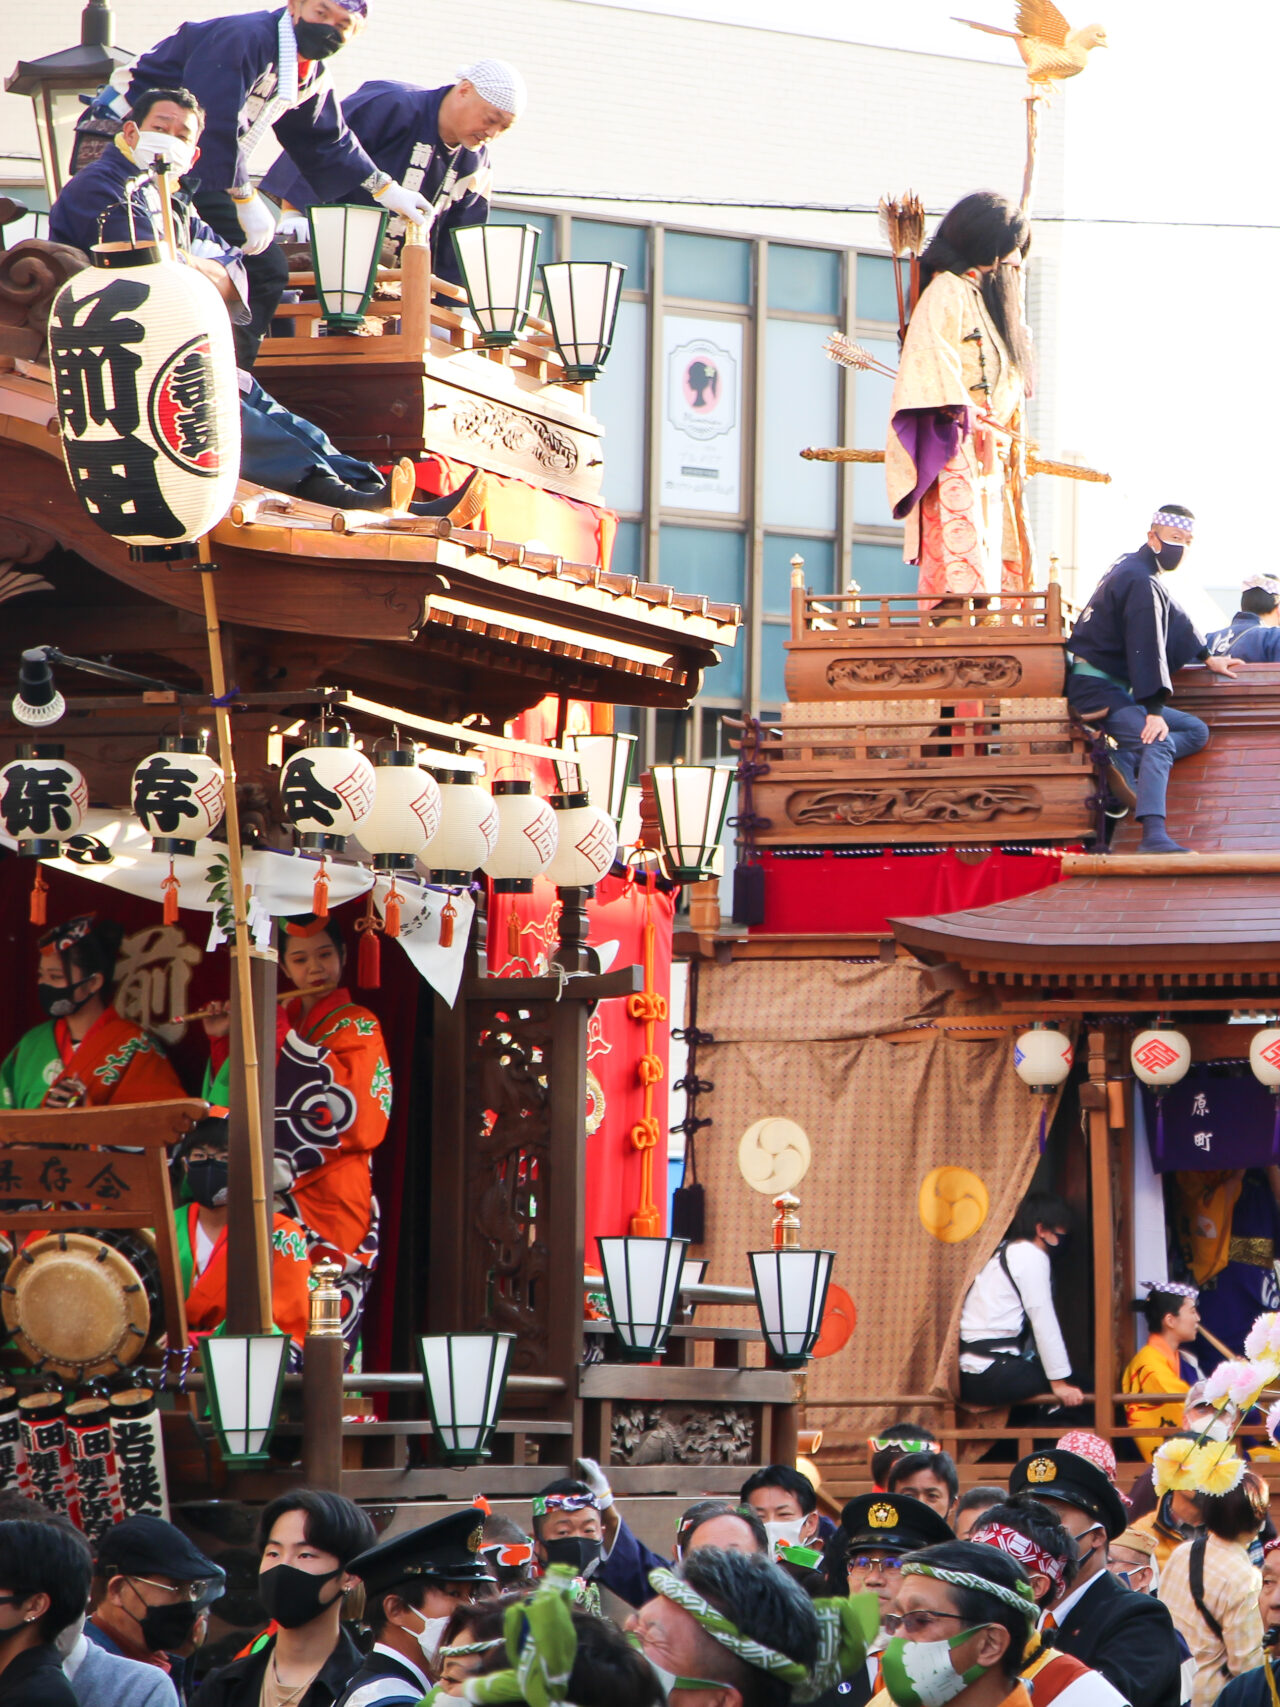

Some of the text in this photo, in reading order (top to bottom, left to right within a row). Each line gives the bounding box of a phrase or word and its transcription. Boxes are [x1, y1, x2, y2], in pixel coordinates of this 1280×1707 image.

[50, 278, 188, 540] 前田
[1, 764, 73, 836] 保
[134, 757, 199, 832] 存
[283, 757, 342, 827] 会
[1191, 1092, 1214, 1152] 原町
